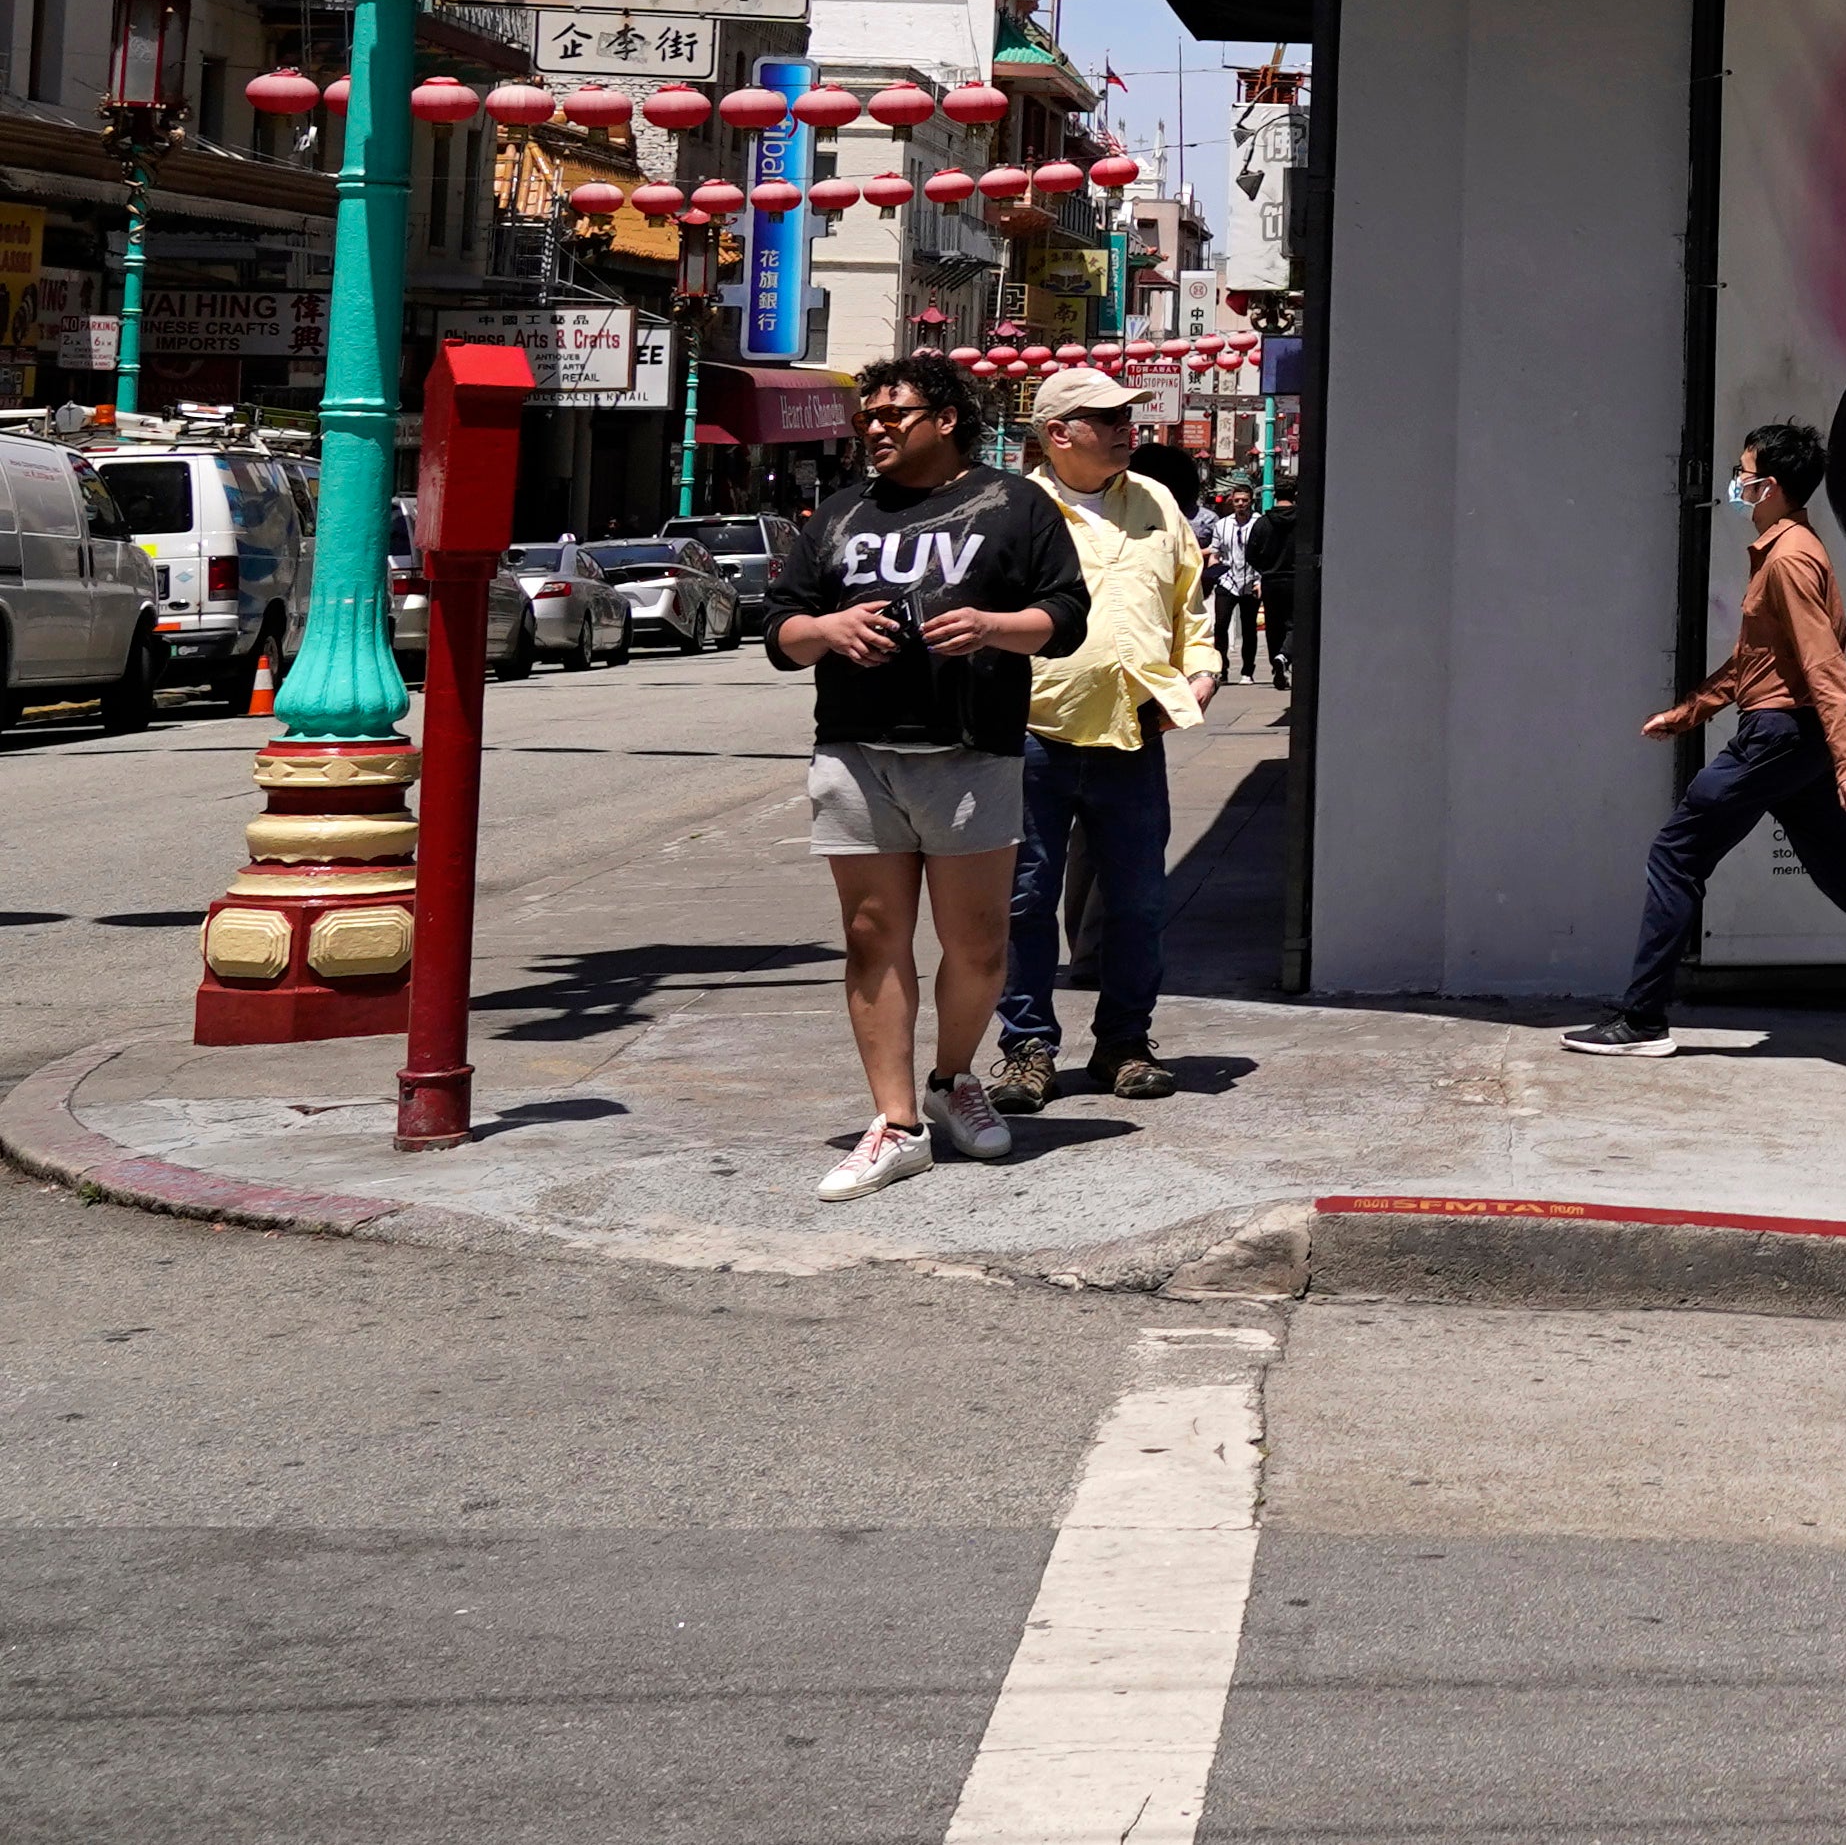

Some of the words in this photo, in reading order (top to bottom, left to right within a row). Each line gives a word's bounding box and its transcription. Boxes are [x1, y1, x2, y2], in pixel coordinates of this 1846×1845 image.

[552, 22, 699, 63] 企李街
[758, 249, 780, 331] 花旗銀行
[196, 295, 277, 318] HING
[62, 317, 78, 331] NO
[80, 321, 117, 331] PARKING
[205, 322, 280, 336] CRAFTS
[288, 293, 325, 354] 偉興
[156, 337, 240, 351] IMPORTS
[514, 329, 548, 348] Arts
[556, 330, 566, 348] &
[574, 329, 620, 349] Crafts
[562, 373, 599, 382] RETAIL
[1144, 378, 1178, 388] STOPPING
[1392, 1198, 1544, 1213] SFMTA
